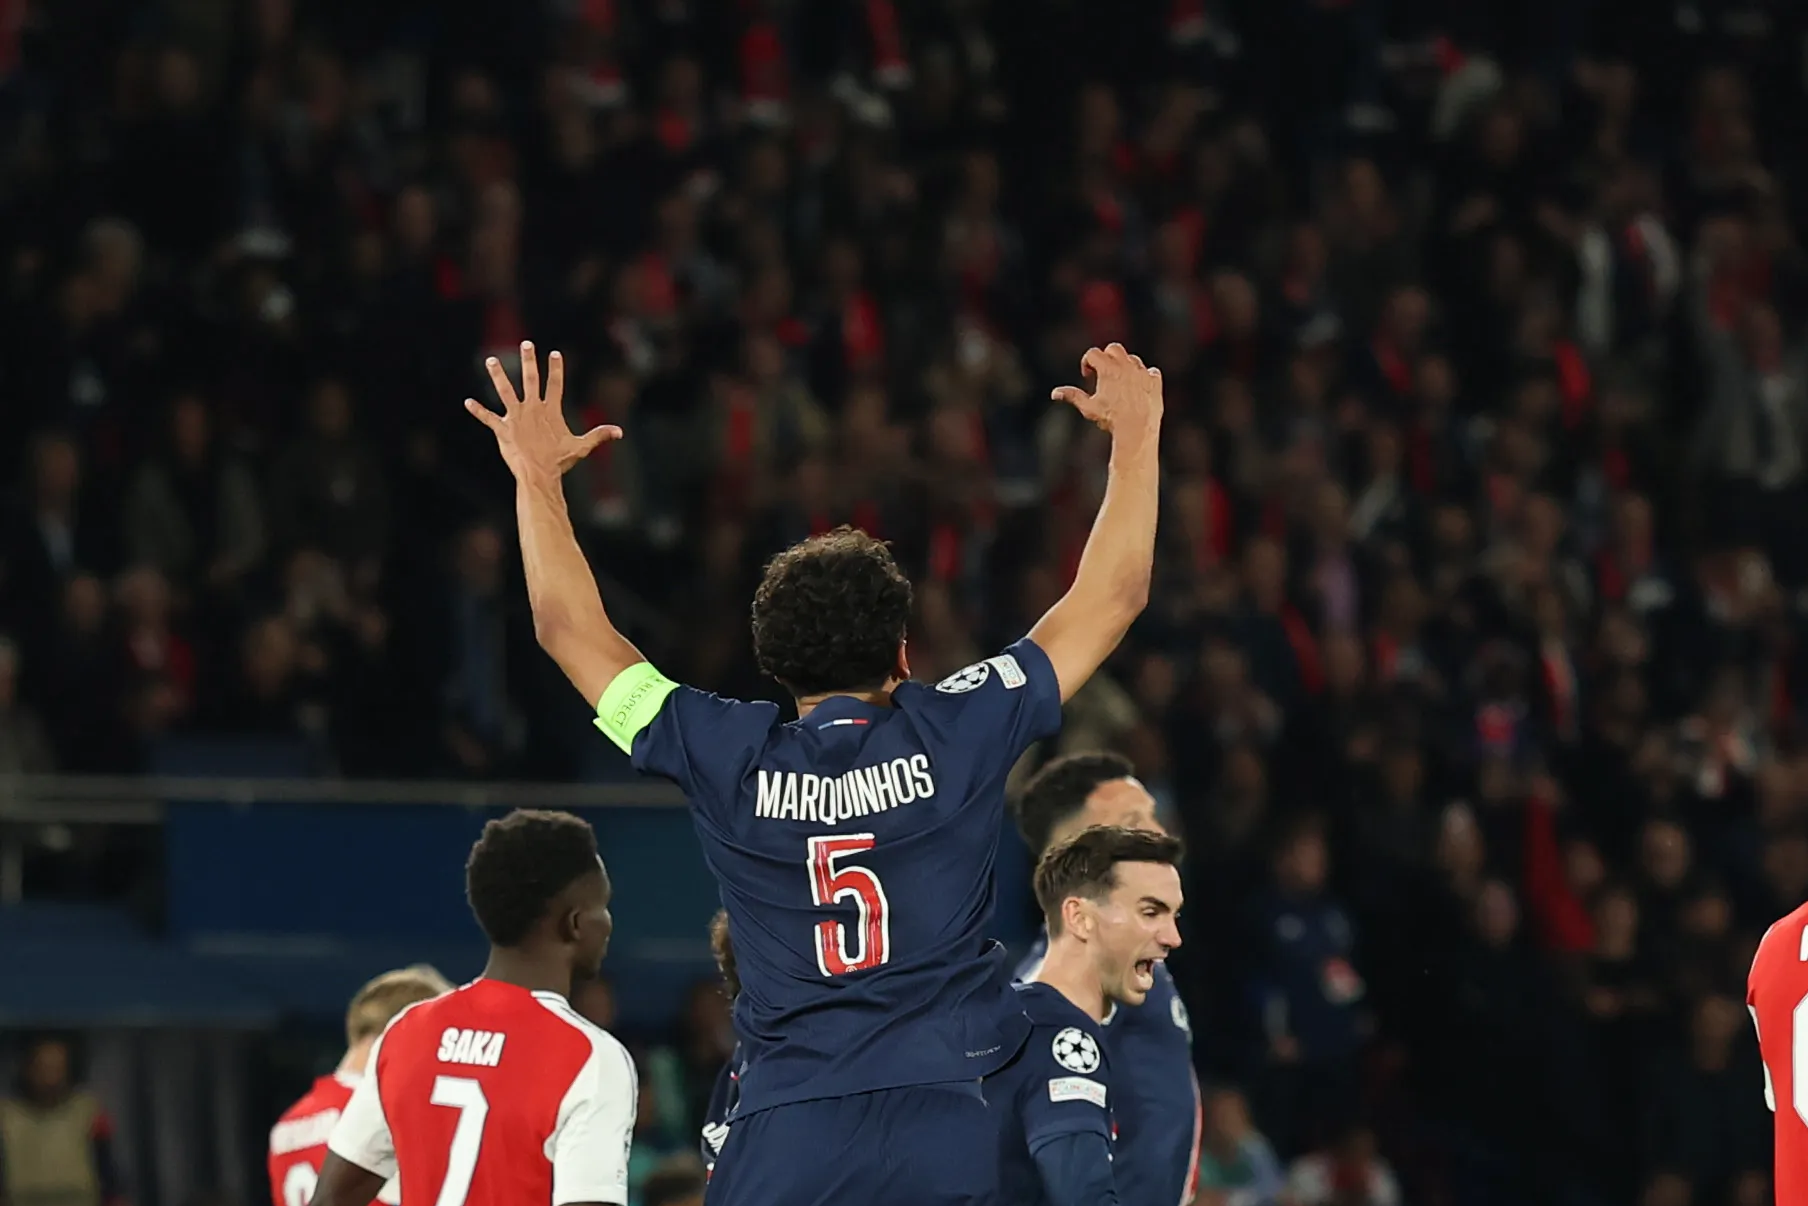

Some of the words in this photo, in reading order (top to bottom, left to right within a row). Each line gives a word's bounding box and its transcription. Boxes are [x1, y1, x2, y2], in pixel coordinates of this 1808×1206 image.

[615, 682, 653, 728] RESPECT
[755, 753, 935, 825] MARQUINHOS
[806, 833, 890, 977] 5
[437, 1027, 506, 1067] SAKA
